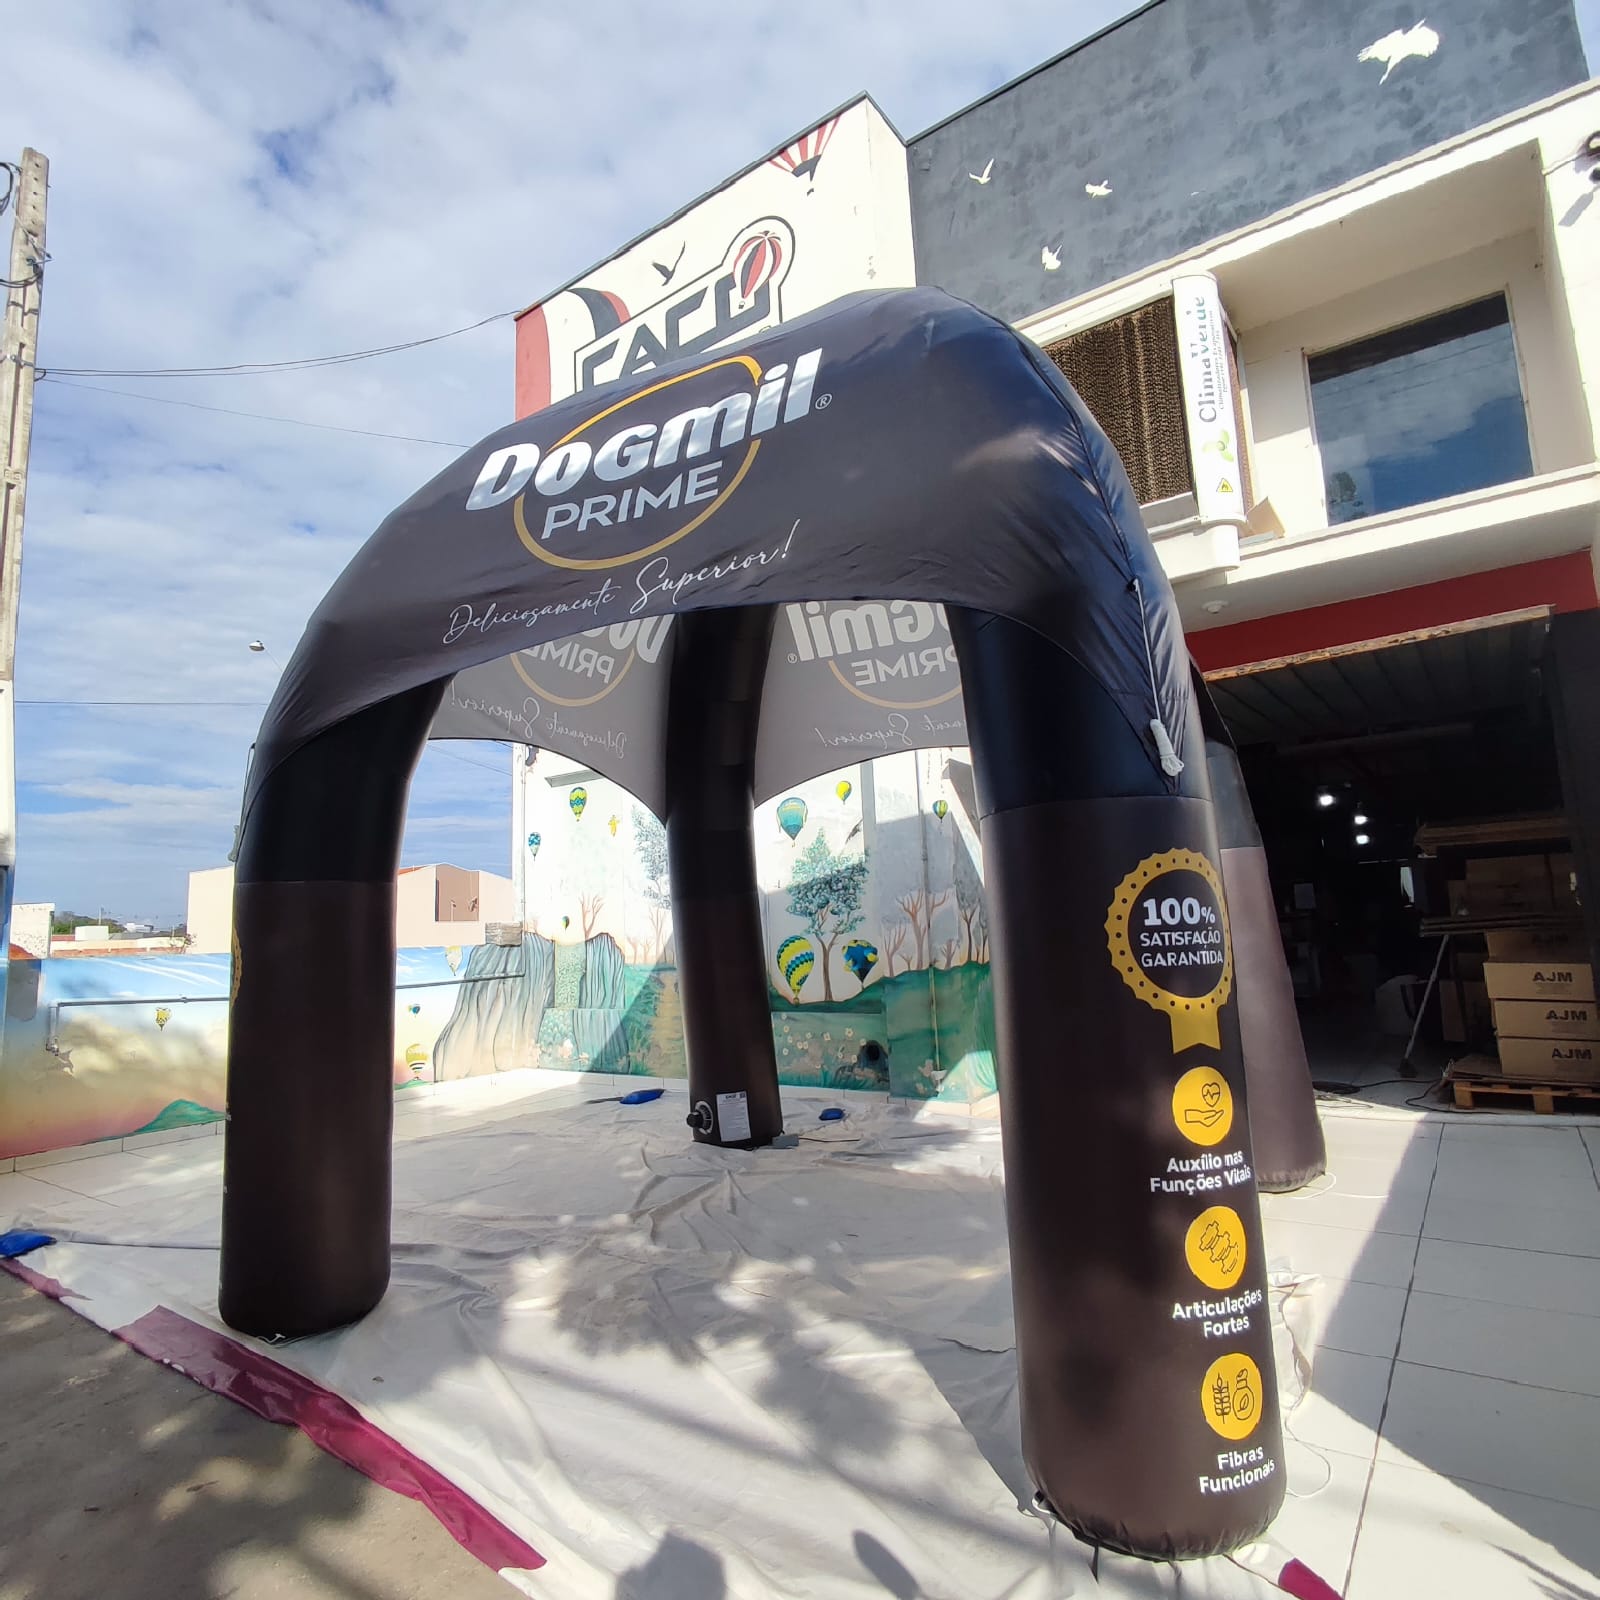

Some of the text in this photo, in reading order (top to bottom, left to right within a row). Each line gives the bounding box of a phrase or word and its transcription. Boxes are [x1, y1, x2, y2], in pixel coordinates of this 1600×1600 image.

[541, 460, 725, 539] PRIME
[442, 580, 621, 645] Deliciosamente
[629, 518, 800, 614] Superior!
[1143, 897, 1216, 926] 100%
[1140, 927, 1221, 948] SATISFAÇÃO
[1141, 950, 1223, 968] GARANTIDA
[1532, 971, 1572, 982] AJM
[1545, 1009, 1587, 1021] AJM
[1552, 1048, 1592, 1060] AJM
[1224, 1151, 1243, 1167] nas
[1150, 1165, 1251, 1195] Funções Vitais
[1172, 1288, 1262, 1320] Articulações
[1204, 1316, 1249, 1338] Fortes
[1217, 1446, 1264, 1470] Fibras
[1199, 1458, 1275, 1494] Funcionais
